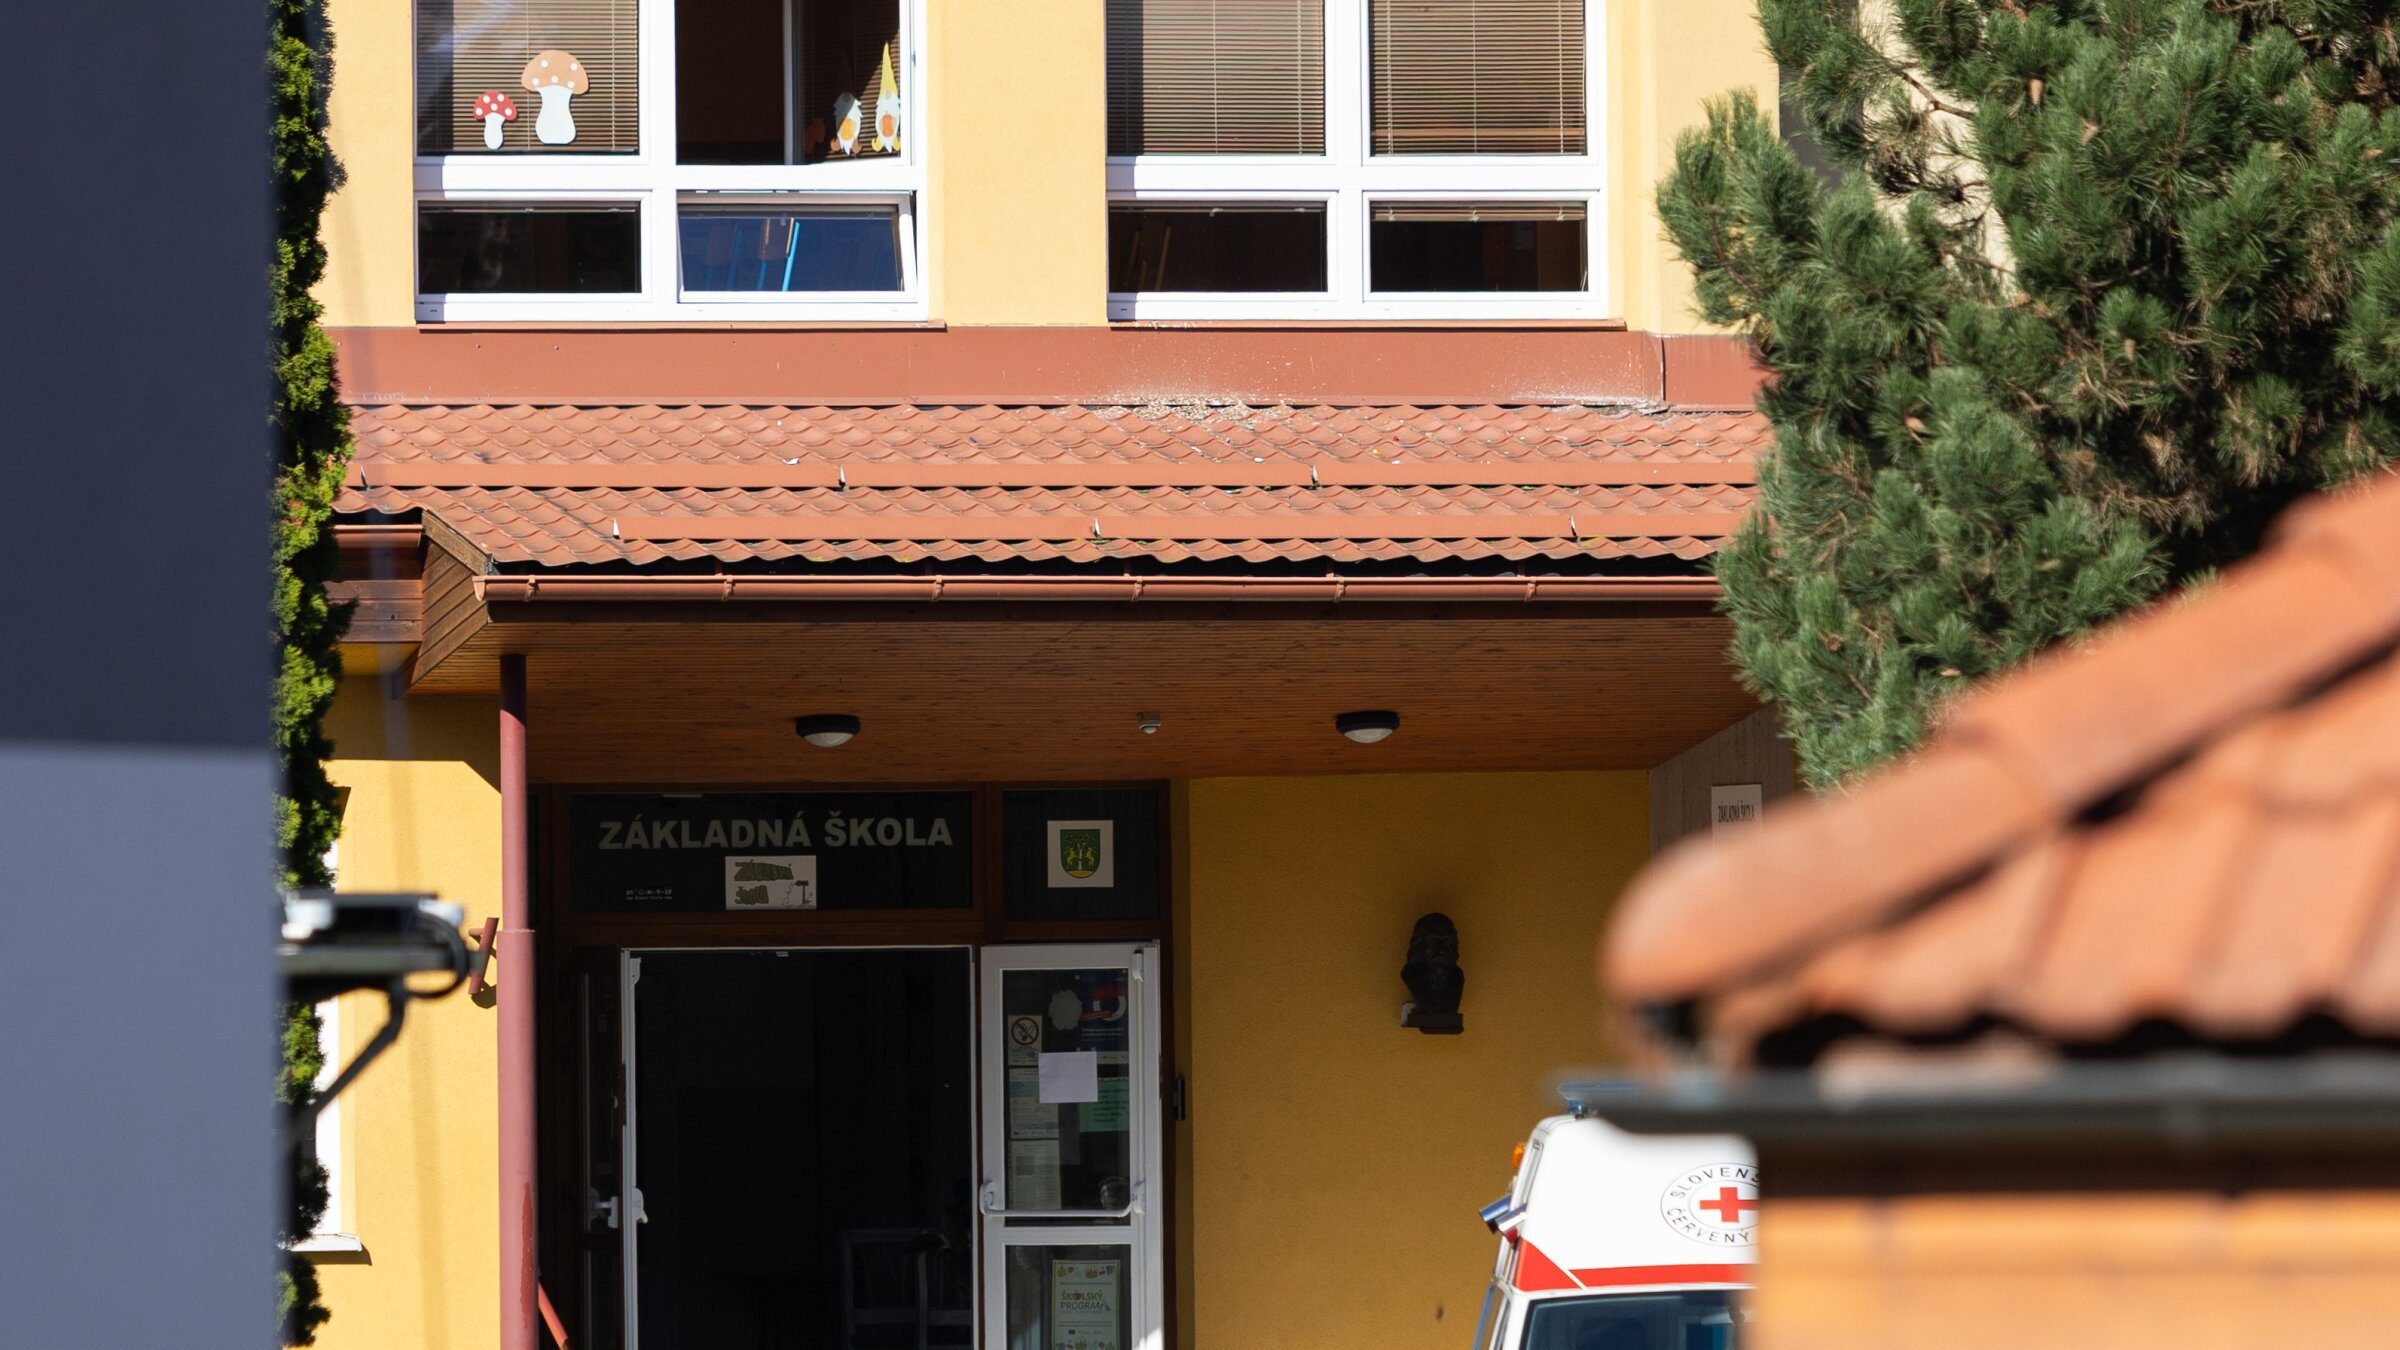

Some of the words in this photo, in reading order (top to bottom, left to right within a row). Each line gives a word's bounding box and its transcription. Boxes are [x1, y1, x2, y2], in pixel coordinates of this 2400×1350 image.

[599, 813, 812, 849] ZÁKLADNÁ
[824, 810, 953, 847] ŠKOLA
[1667, 1207, 1749, 1243] ČERVENÝ
